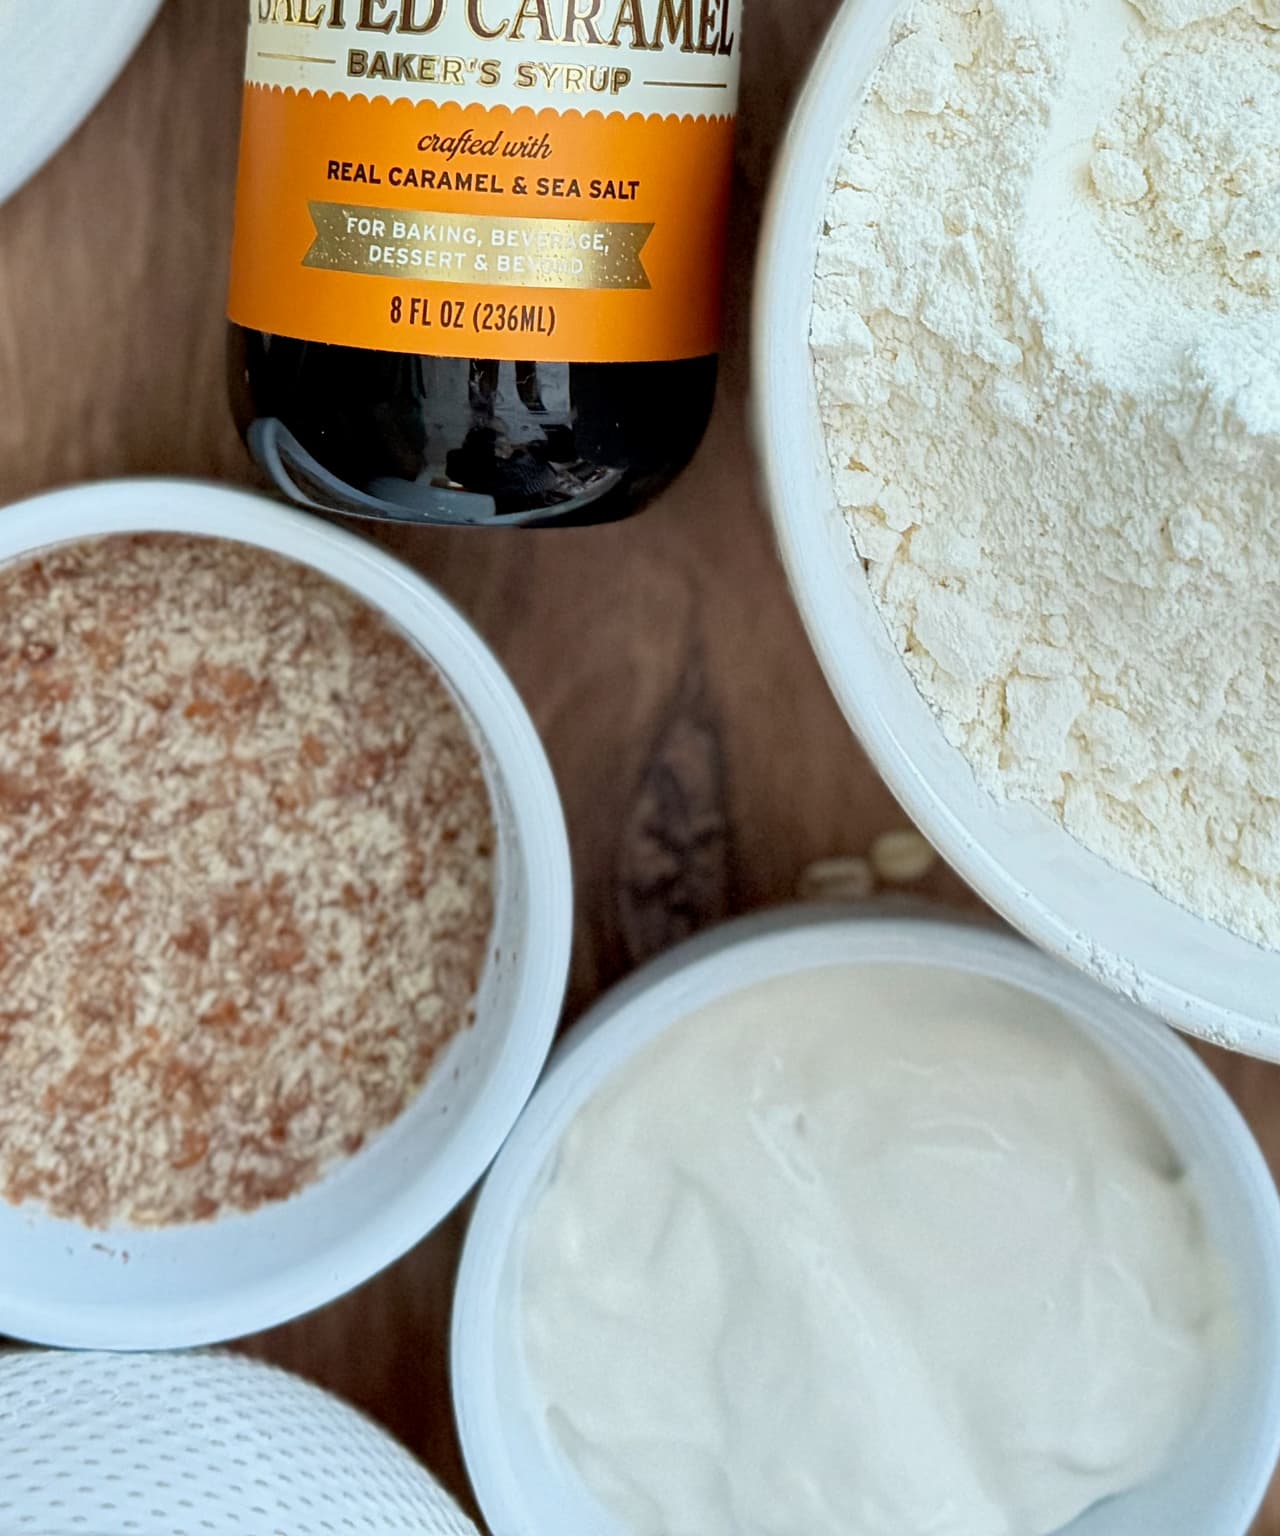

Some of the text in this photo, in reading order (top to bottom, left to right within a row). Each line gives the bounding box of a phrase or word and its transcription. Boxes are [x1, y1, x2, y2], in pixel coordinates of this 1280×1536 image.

[346, 49, 632, 96] BAKER'S SYRUP
[417, 128, 553, 162] crafted with
[327, 160, 640, 201] REAL CARAMEL & SEA SALT
[346, 216, 386, 238] FOR
[393, 221, 483, 248] BAKING,
[369, 245, 467, 268] DESSERT
[475, 253, 488, 272] &
[390, 295, 557, 337] 8 FL OZ (236ML)
